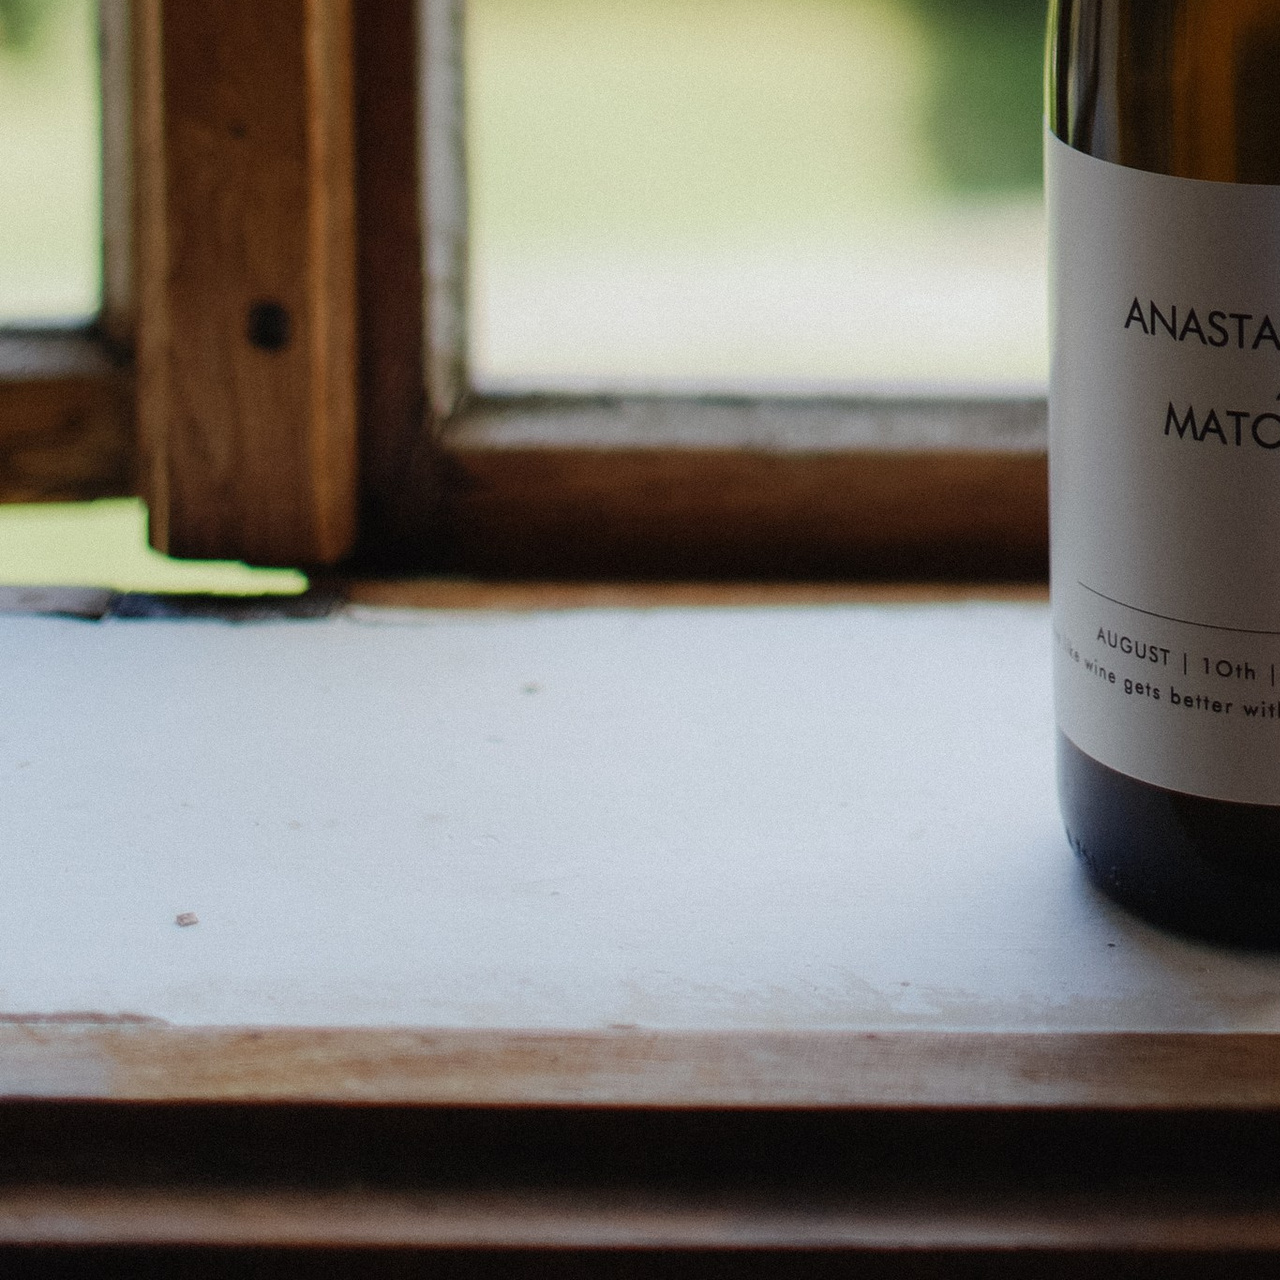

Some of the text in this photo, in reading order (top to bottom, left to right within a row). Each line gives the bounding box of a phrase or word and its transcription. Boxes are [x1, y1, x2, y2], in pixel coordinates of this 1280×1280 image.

[1097, 627, 1170, 665] AUGUST
[1083, 658, 1116, 684] wine
[1124, 678, 1160, 700] gets
[1170, 686, 1232, 714] better
